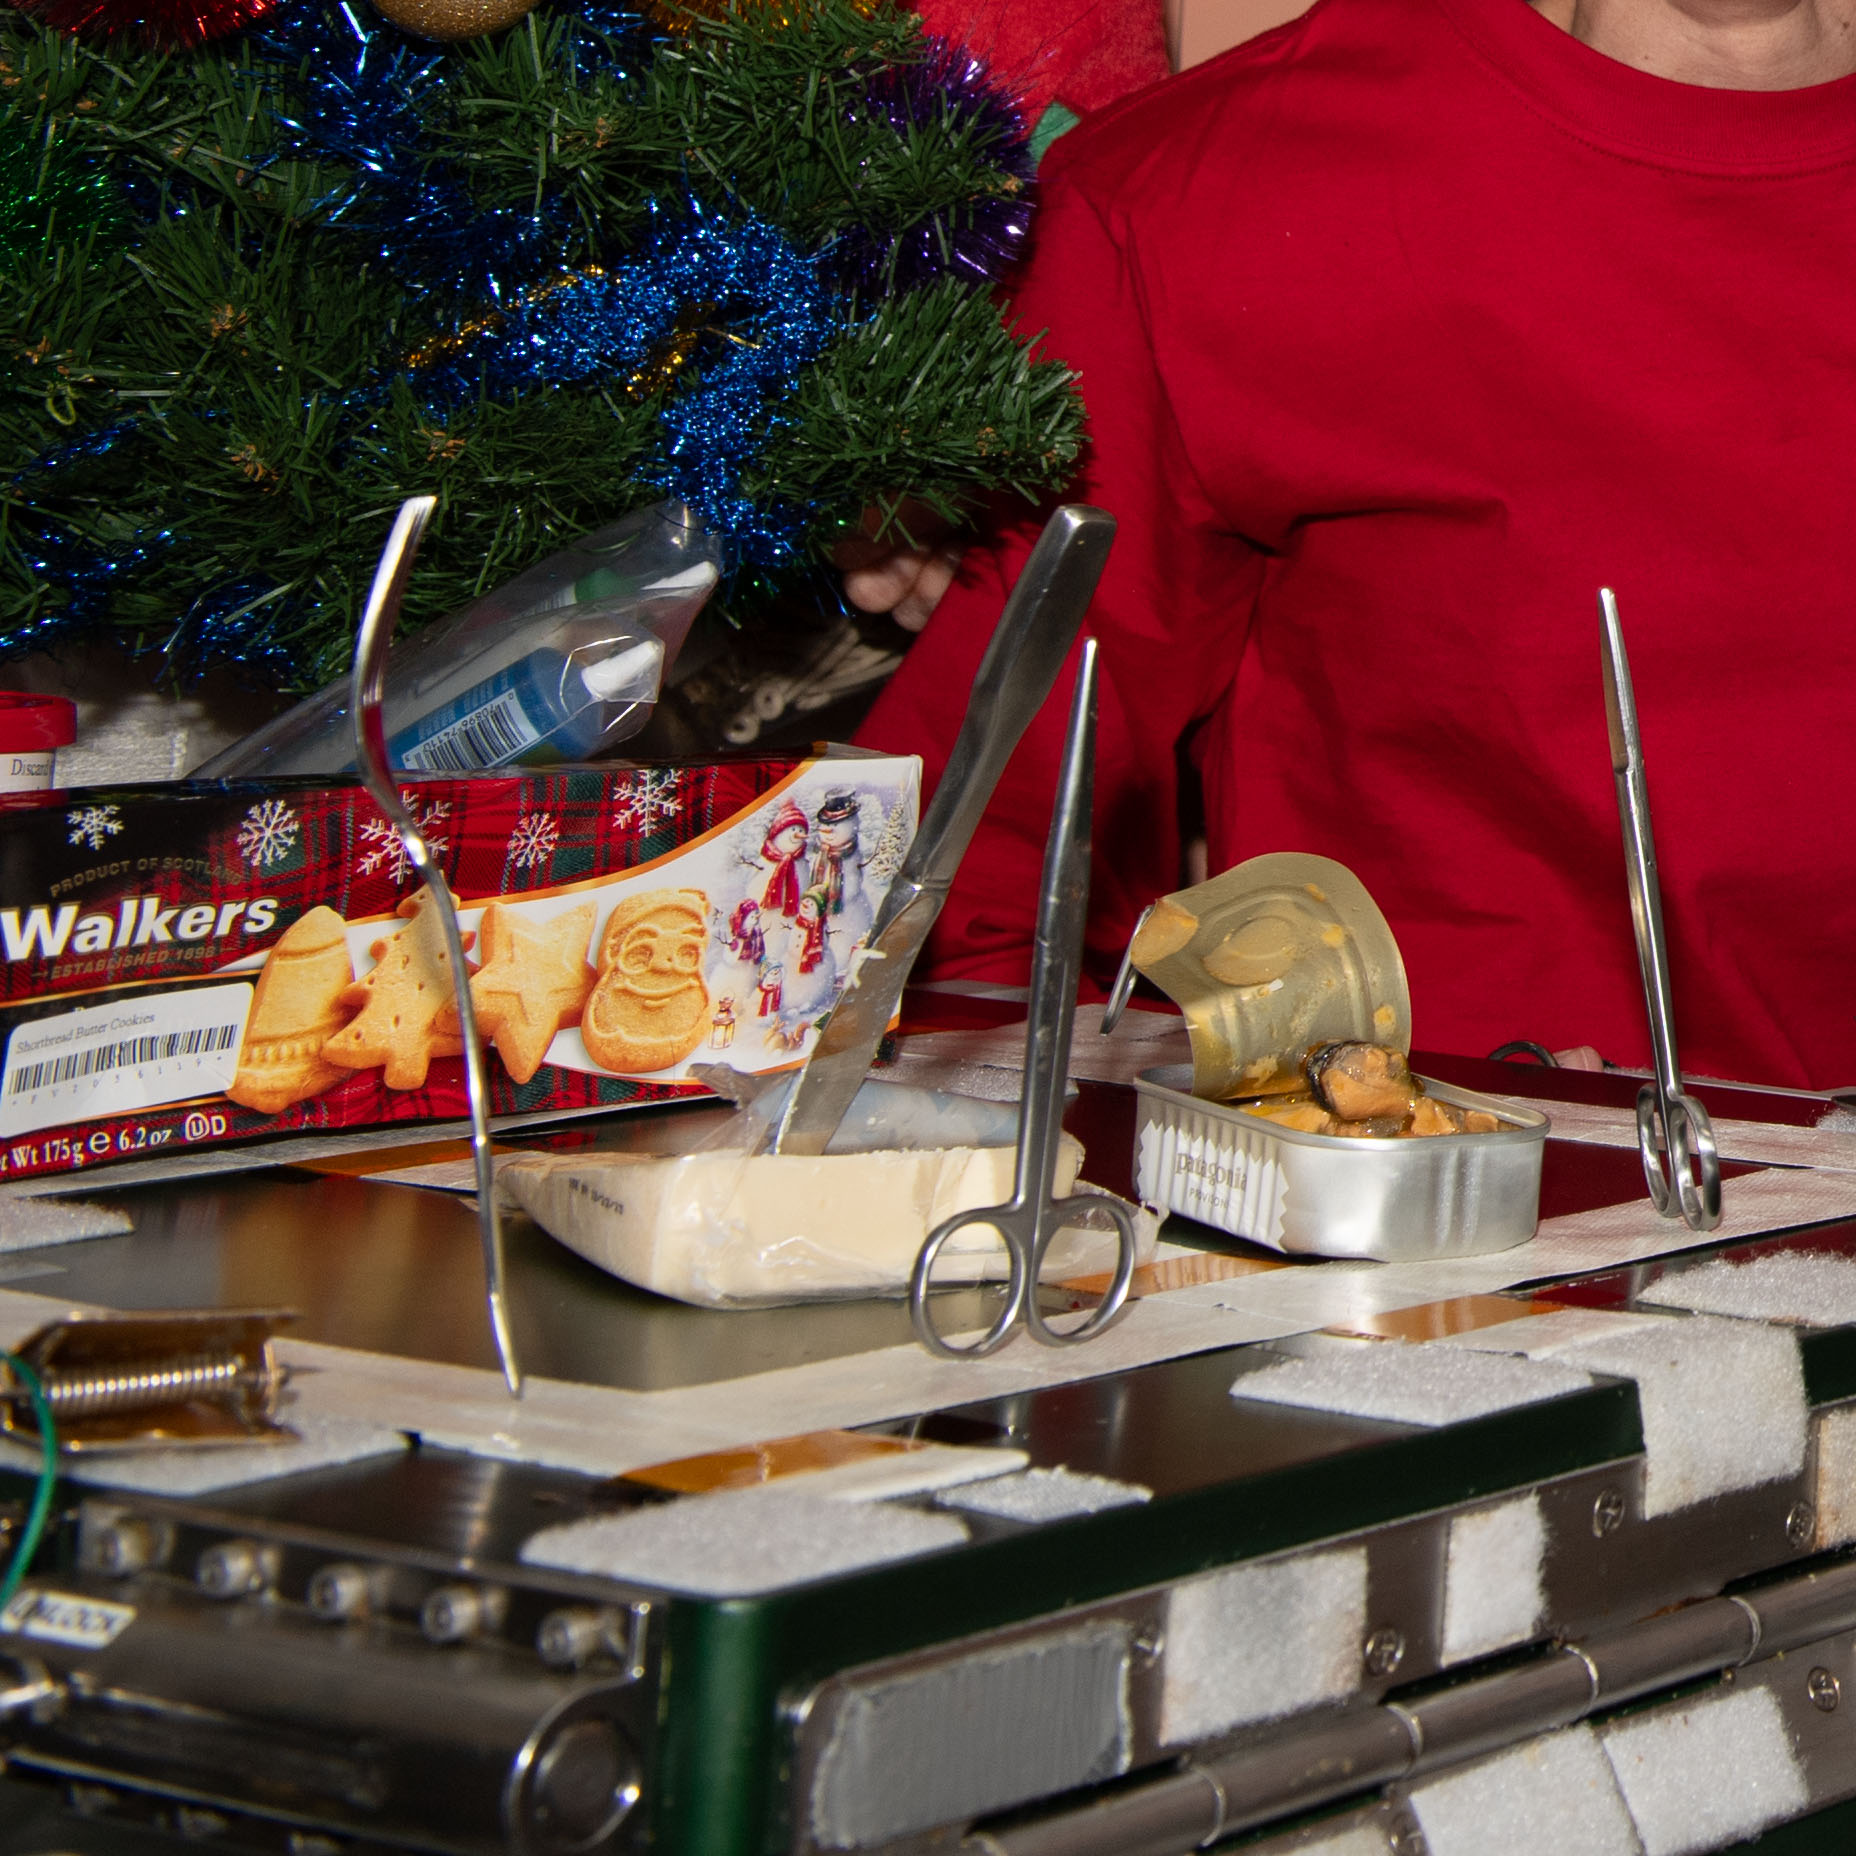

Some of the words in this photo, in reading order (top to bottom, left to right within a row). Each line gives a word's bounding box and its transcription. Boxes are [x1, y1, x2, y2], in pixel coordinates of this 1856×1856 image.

[50, 860, 131, 898] PRODUCT
[136, 857, 159, 872] OF
[162, 856, 243, 886] SCOTLAND
[0, 895, 281, 964] Walkers
[51, 950, 170, 980] ESTABLISHED
[175, 945, 217, 961] 1898
[15, 1030, 74, 1055] Shortbread
[74, 1021, 108, 1041] Butter
[110, 1012, 156, 1031] Cookies
[11, 1139, 40, 1169] Wt
[43, 1137, 85, 1169] 175g
[118, 1126, 147, 1152] 6.2
[150, 1128, 173, 1145] oz
[1176, 1152, 1248, 1193] patagonia
